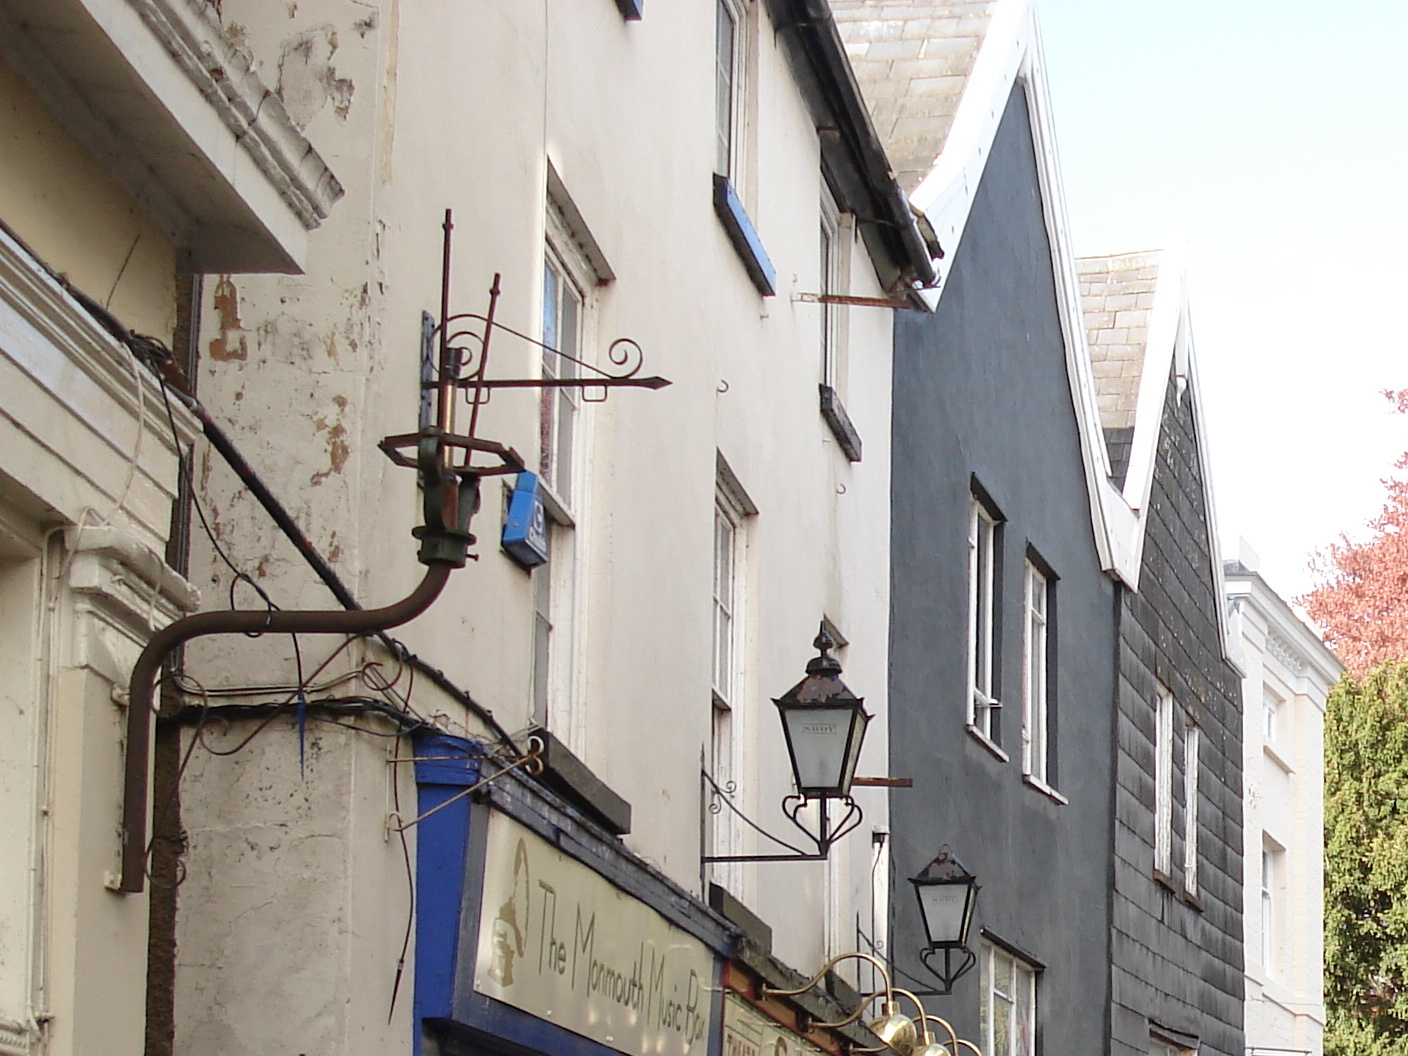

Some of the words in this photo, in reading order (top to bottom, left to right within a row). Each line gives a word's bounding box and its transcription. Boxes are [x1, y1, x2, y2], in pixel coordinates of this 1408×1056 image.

[538, 878, 567, 976] The
[570, 901, 645, 1014] Monmouth
[647, 946, 683, 1033] Music
[685, 968, 706, 1046] Box
